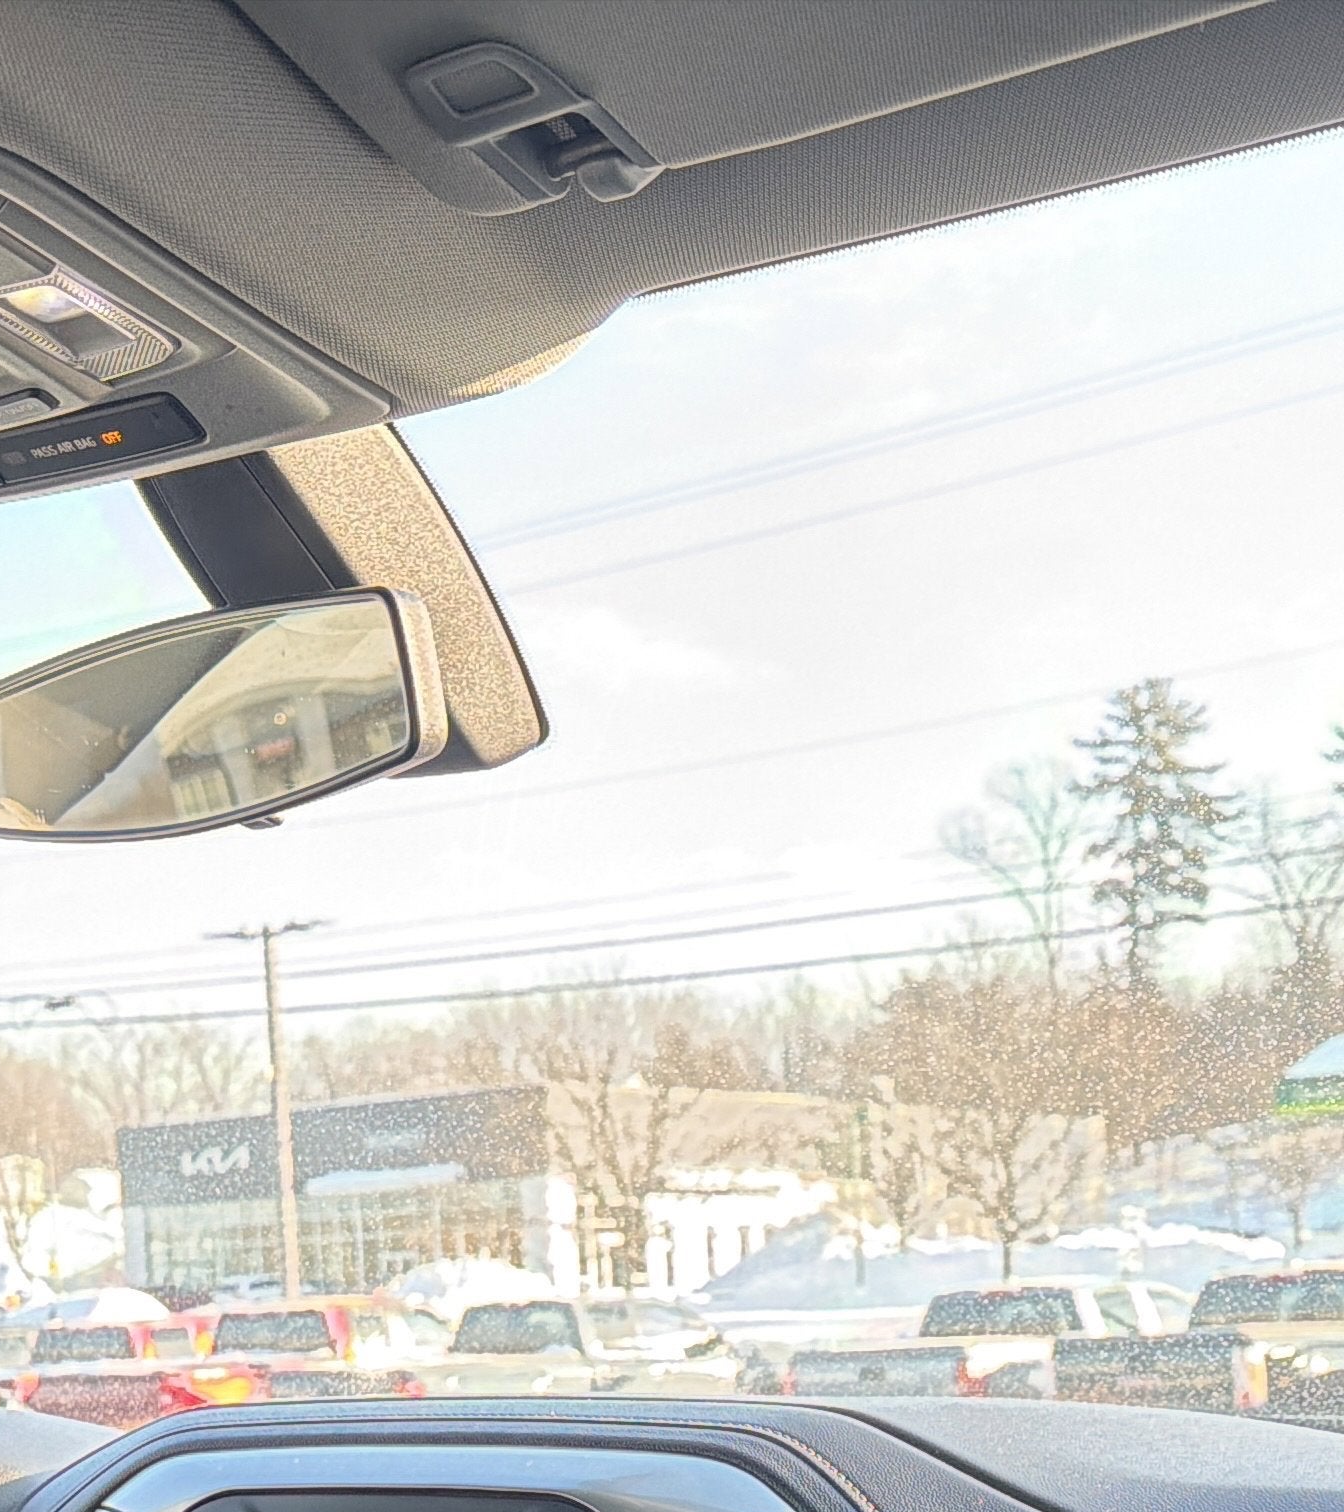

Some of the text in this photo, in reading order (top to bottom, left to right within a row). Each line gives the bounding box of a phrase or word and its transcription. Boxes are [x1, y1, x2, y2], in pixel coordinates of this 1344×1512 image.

[30, 430, 122, 459] PASS AIR BAG OFF
